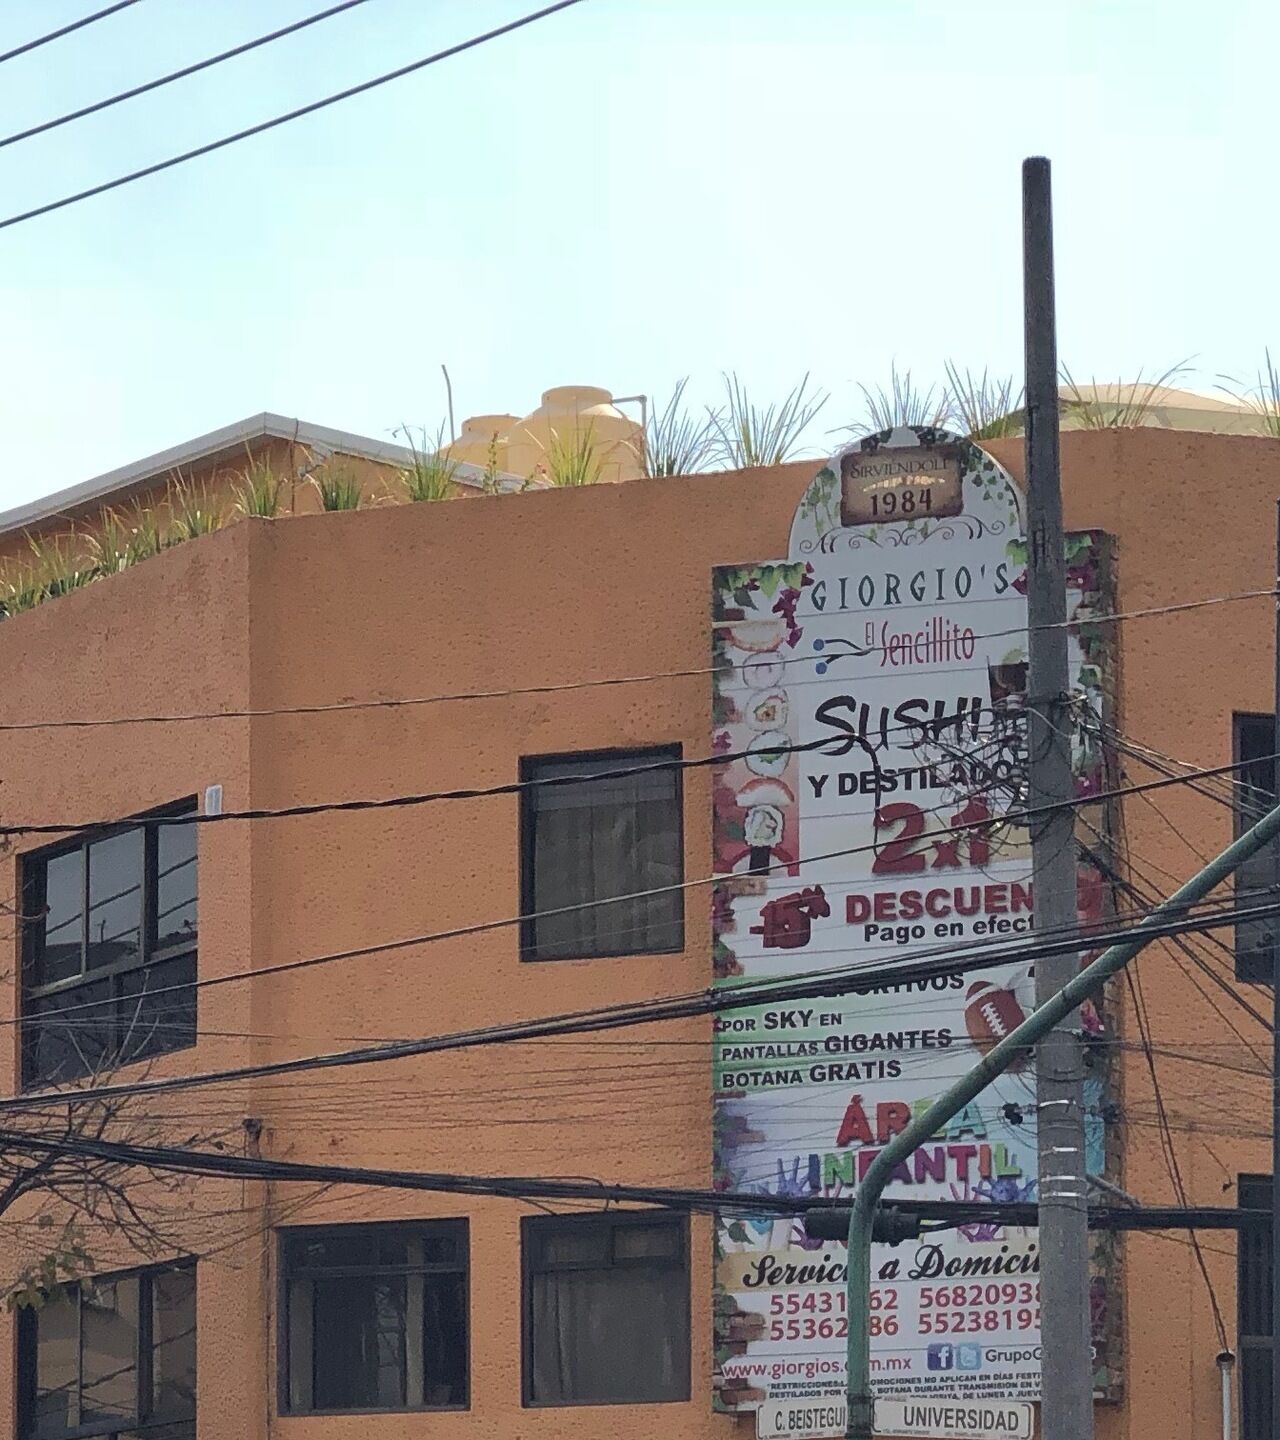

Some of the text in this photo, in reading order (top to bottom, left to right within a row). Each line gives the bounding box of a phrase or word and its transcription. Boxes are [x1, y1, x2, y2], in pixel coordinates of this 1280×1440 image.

[870, 488, 932, 515] 1984
[810, 562, 1009, 611] GIORGIO'S
[866, 616, 975, 667] El Sencillito
[814, 695, 982, 756] SUSHI
[807, 775, 829, 798] Y
[846, 883, 1033, 924] DESCUEN
[864, 913, 1034, 944] Pago en efect
[722, 1009, 842, 1033] POR SKY EN
[722, 1028, 953, 1061] PANTALLAS GIGANTES
[722, 1059, 902, 1088] BOTANA GRATIS
[742, 1254, 849, 1287] Servic
[878, 1258, 900, 1280] a
[770, 1289, 899, 1316] 5543162
[770, 1315, 899, 1341] 5536286
[723, 1356, 912, 1380] www.giorgios.m.mx
[775, 1407, 846, 1431] C. BEISTEGUI
[904, 1406, 1019, 1431] UNIVERSIDAD
